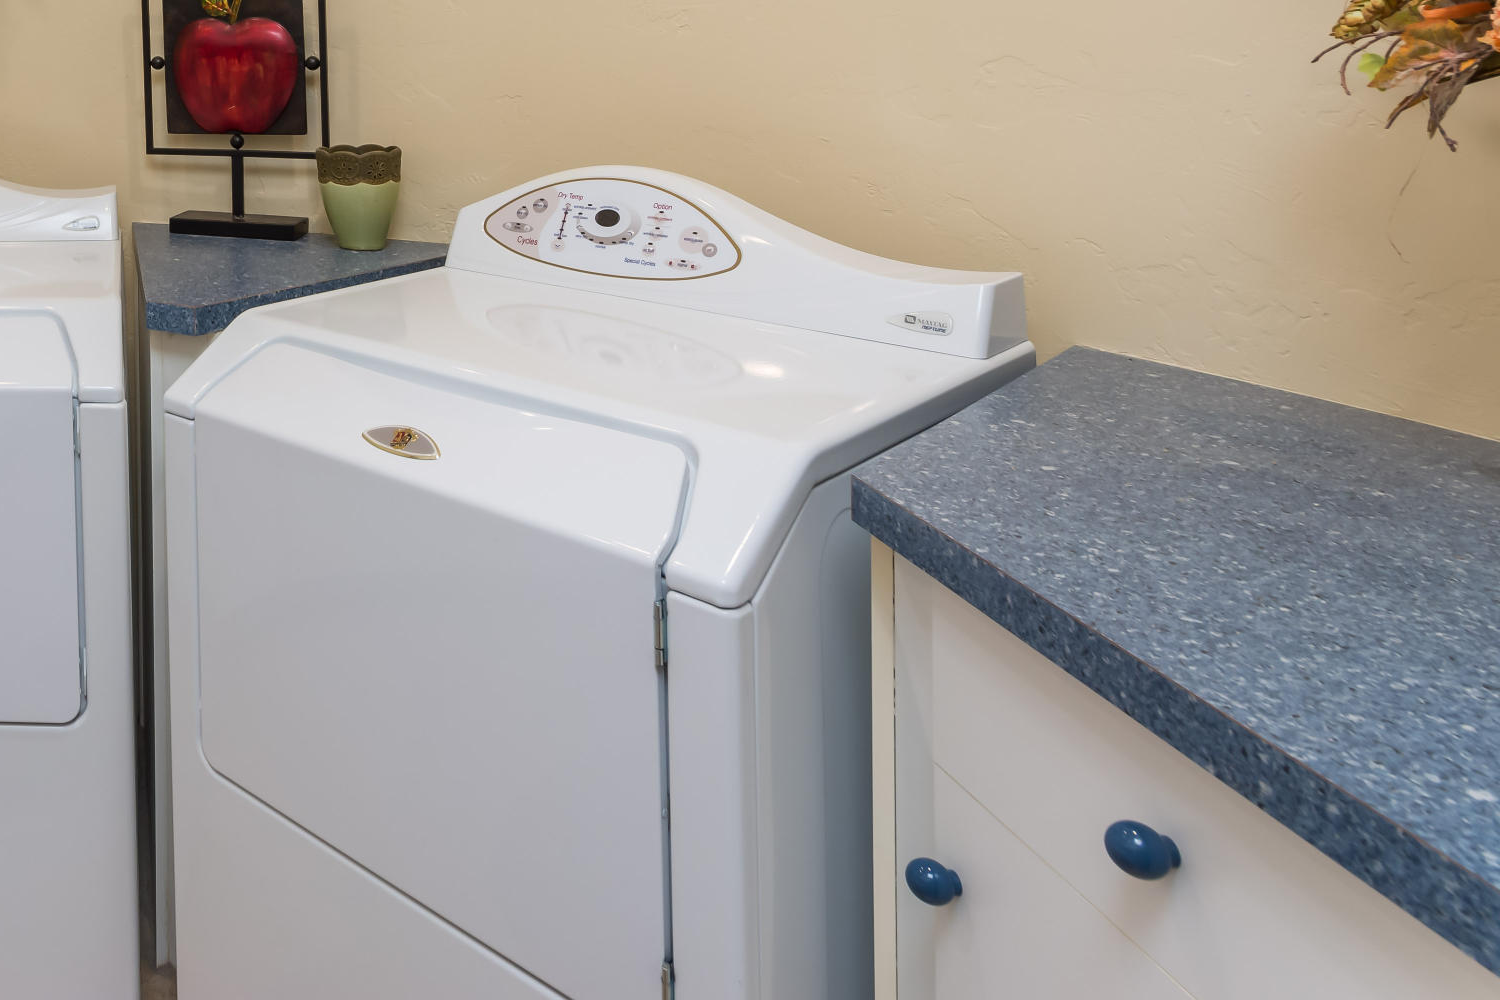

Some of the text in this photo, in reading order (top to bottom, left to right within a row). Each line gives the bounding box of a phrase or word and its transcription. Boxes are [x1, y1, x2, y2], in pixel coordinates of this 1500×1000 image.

[558, 192, 584, 201] Dry Temp
[517, 235, 538, 246] Cycles
